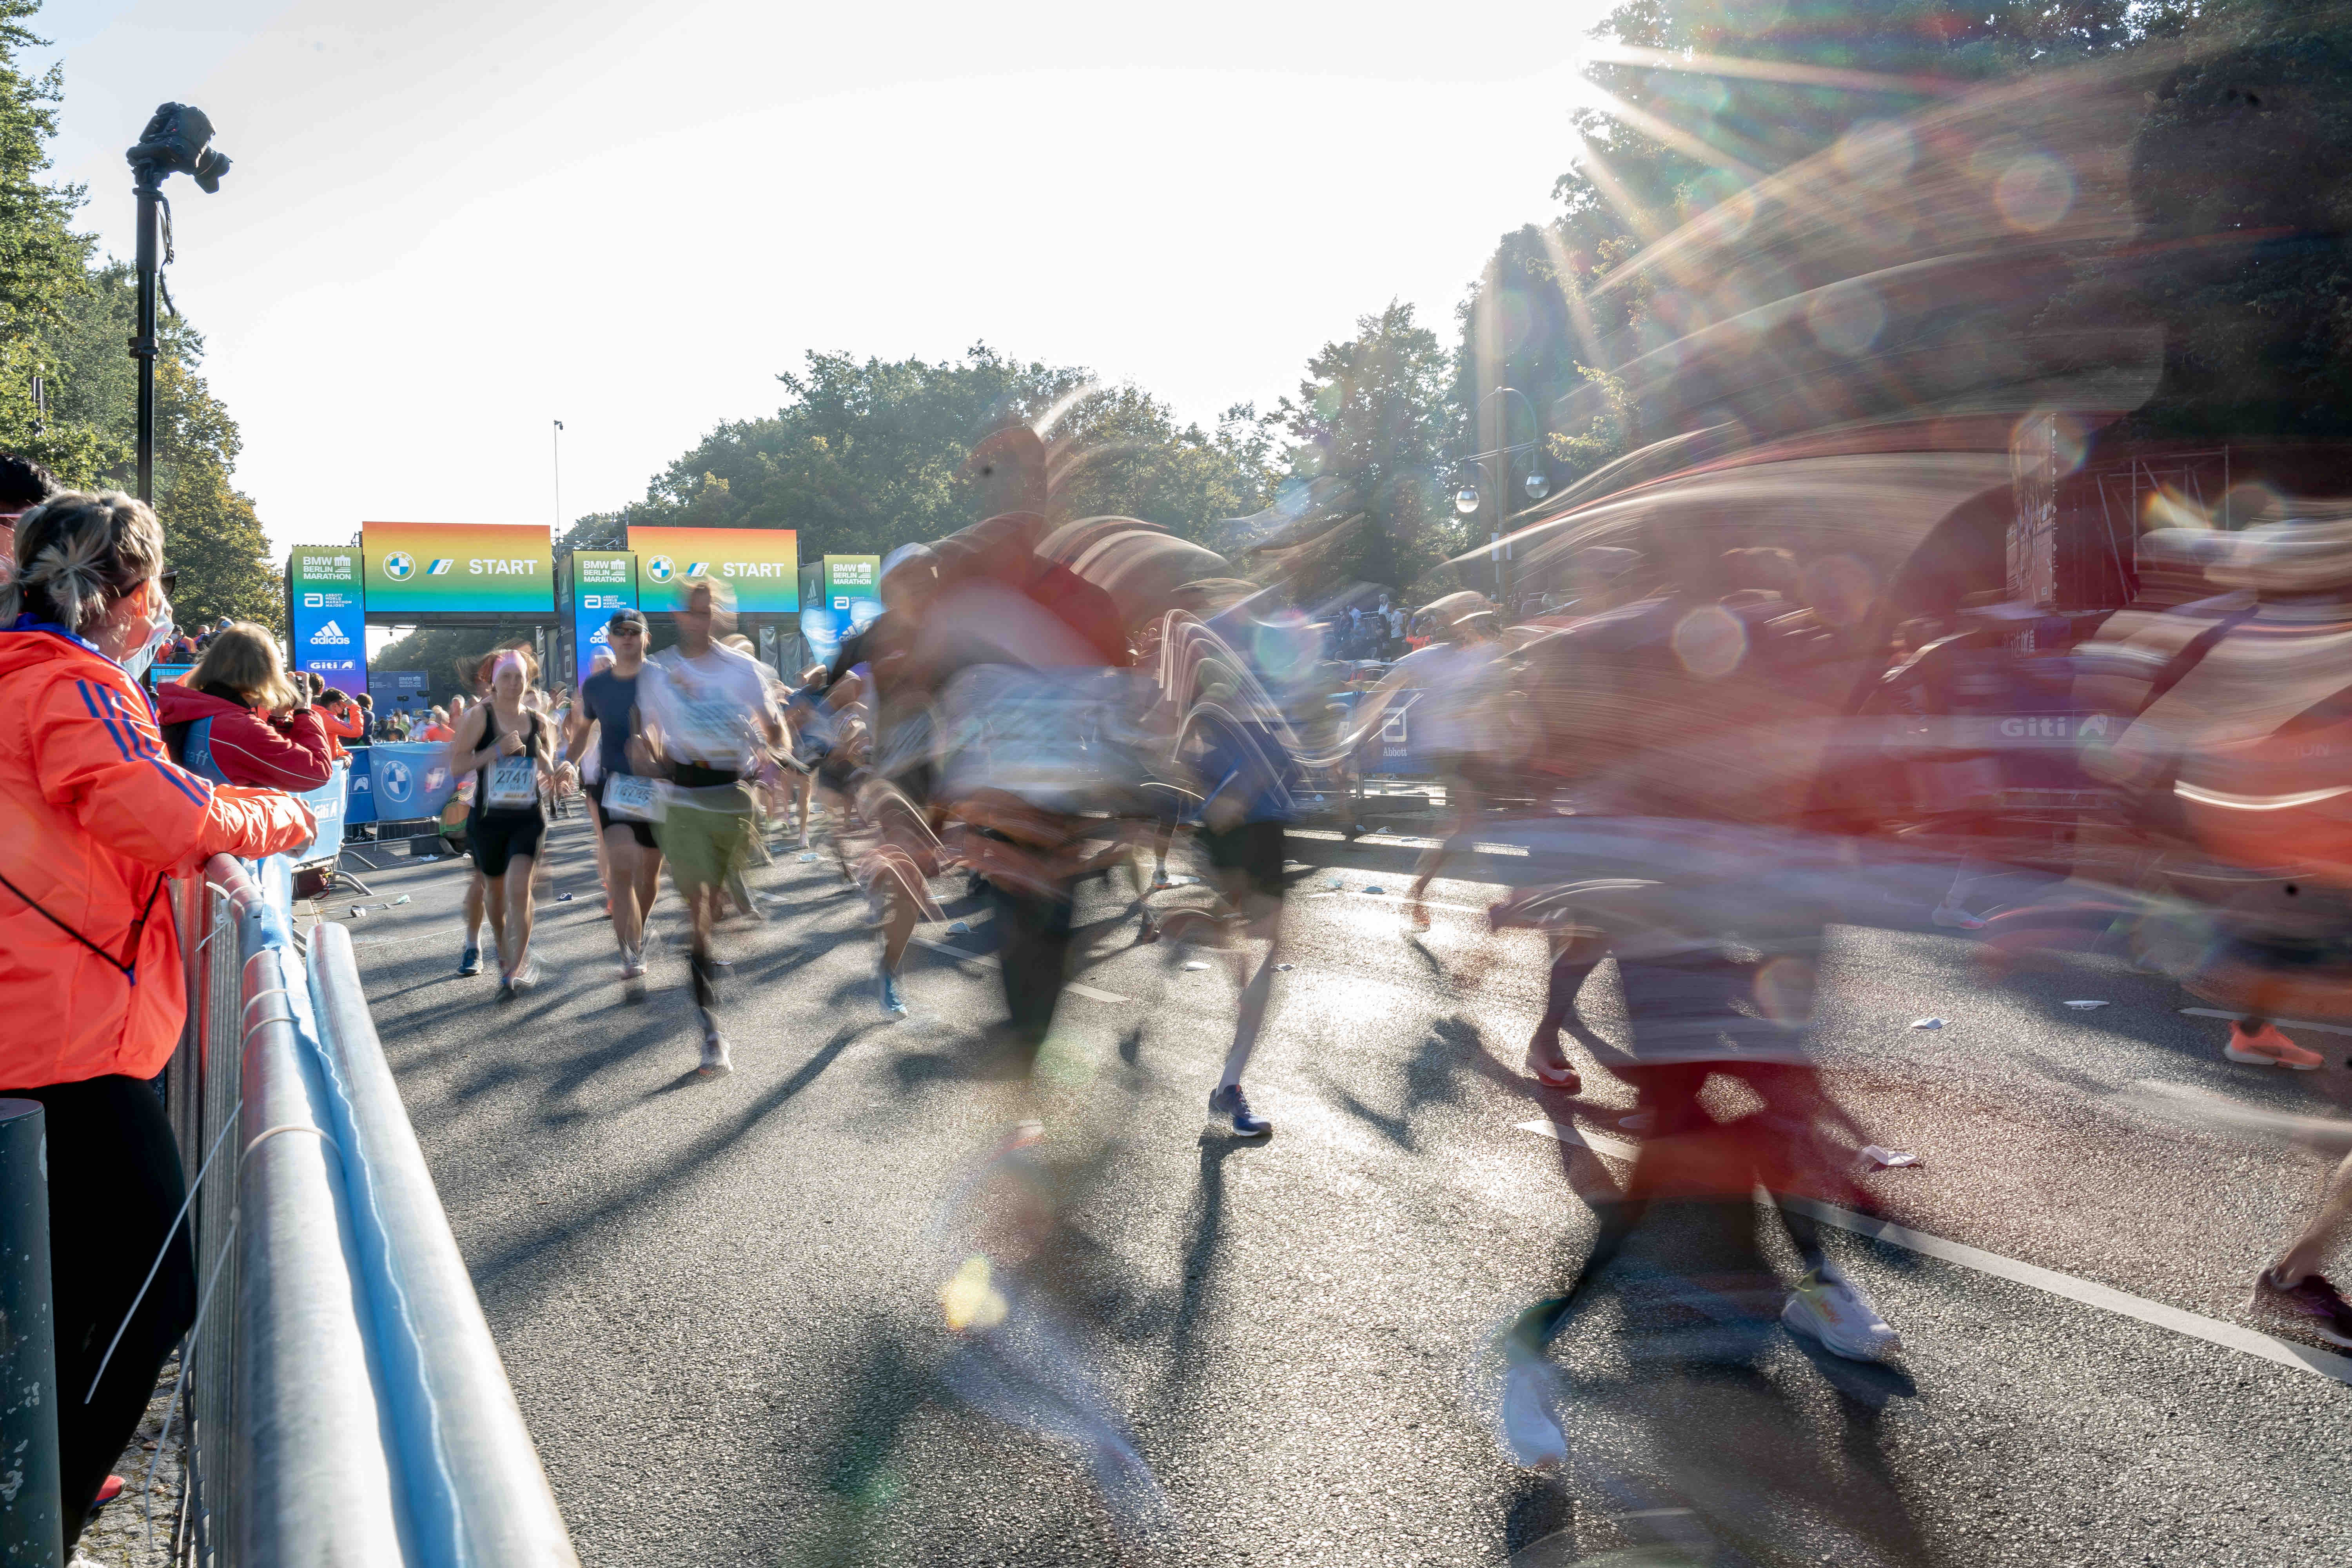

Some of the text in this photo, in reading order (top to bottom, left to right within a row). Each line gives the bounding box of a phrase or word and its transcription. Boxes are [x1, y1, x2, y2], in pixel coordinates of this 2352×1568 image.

[303, 556, 333, 565] BMW
[583, 560, 609, 569] BMW
[469, 559, 537, 574] START
[723, 562, 784, 577] START
[833, 564, 857, 572] BMW
[310, 635, 350, 645] adidas
[2000, 717, 2066, 737] Giti
[1383, 746, 1407, 757] Abbott
[314, 803, 330, 819] Giti
